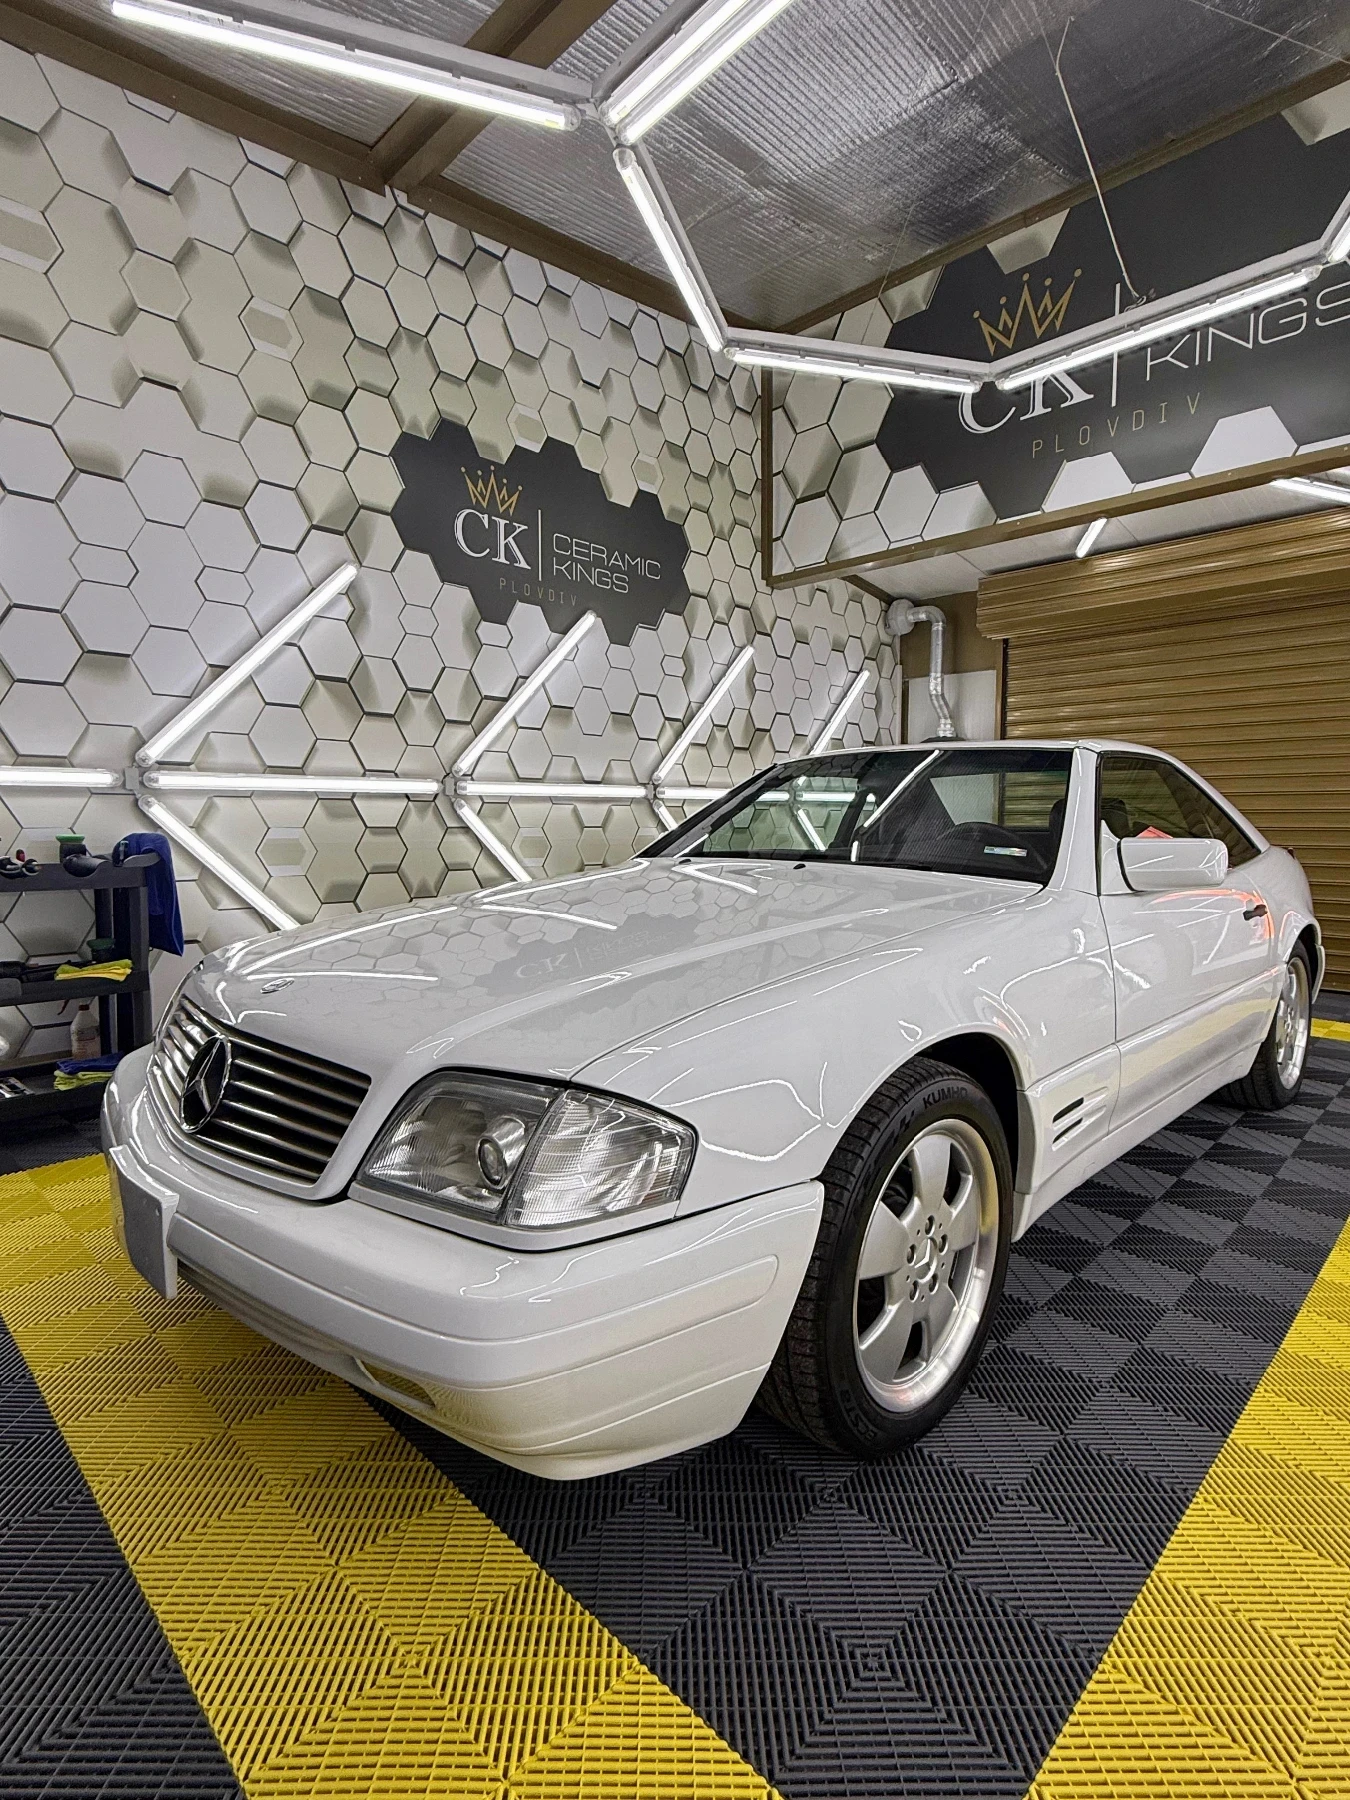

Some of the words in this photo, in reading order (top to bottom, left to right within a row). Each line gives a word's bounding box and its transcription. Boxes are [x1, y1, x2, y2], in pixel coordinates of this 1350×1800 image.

[1032, 392, 1202, 459] PLOVDIV
[454, 508, 532, 570] CK
[552, 532, 661, 580] CERAMIC
[499, 577, 578, 607] PLOVDIV
[552, 557, 629, 594] KINGS
[922, 1086, 969, 1110] KUMHO
